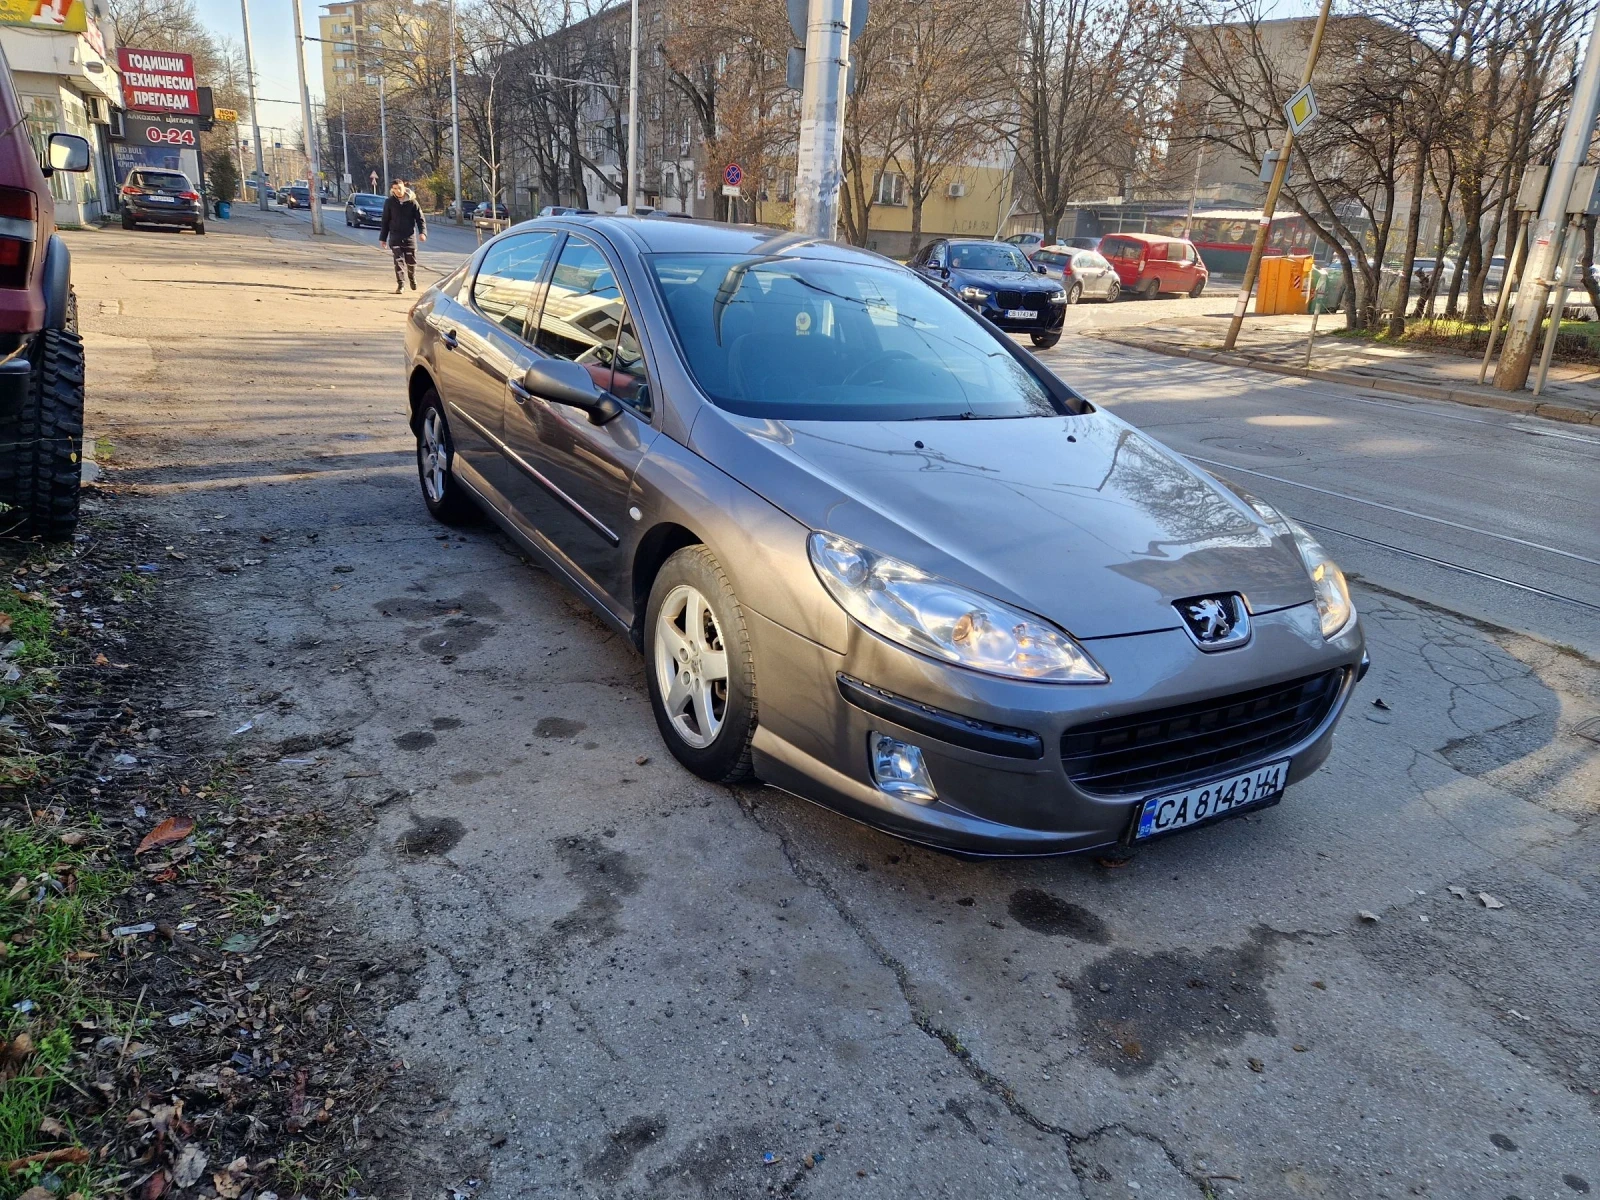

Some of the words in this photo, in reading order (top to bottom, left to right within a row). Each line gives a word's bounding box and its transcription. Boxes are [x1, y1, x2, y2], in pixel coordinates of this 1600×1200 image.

[128, 53, 184, 72] ГОДИШНИ
[123, 71, 194, 91] ТЕХНИЧЕСКИ
[134, 91, 189, 110] ПРЕГЛЕДИ
[127, 113, 161, 122] АЛКОХОЛ
[165, 116, 194, 125] ЦИГАРИ
[146, 126, 195, 146] 0-24
[117, 153, 134, 161] ДАВА
[128, 147, 142, 155] BULL
[1155, 795, 1189, 829] CA
[1194, 777, 1252, 820] 8143
[1252, 768, 1281, 799] HA
